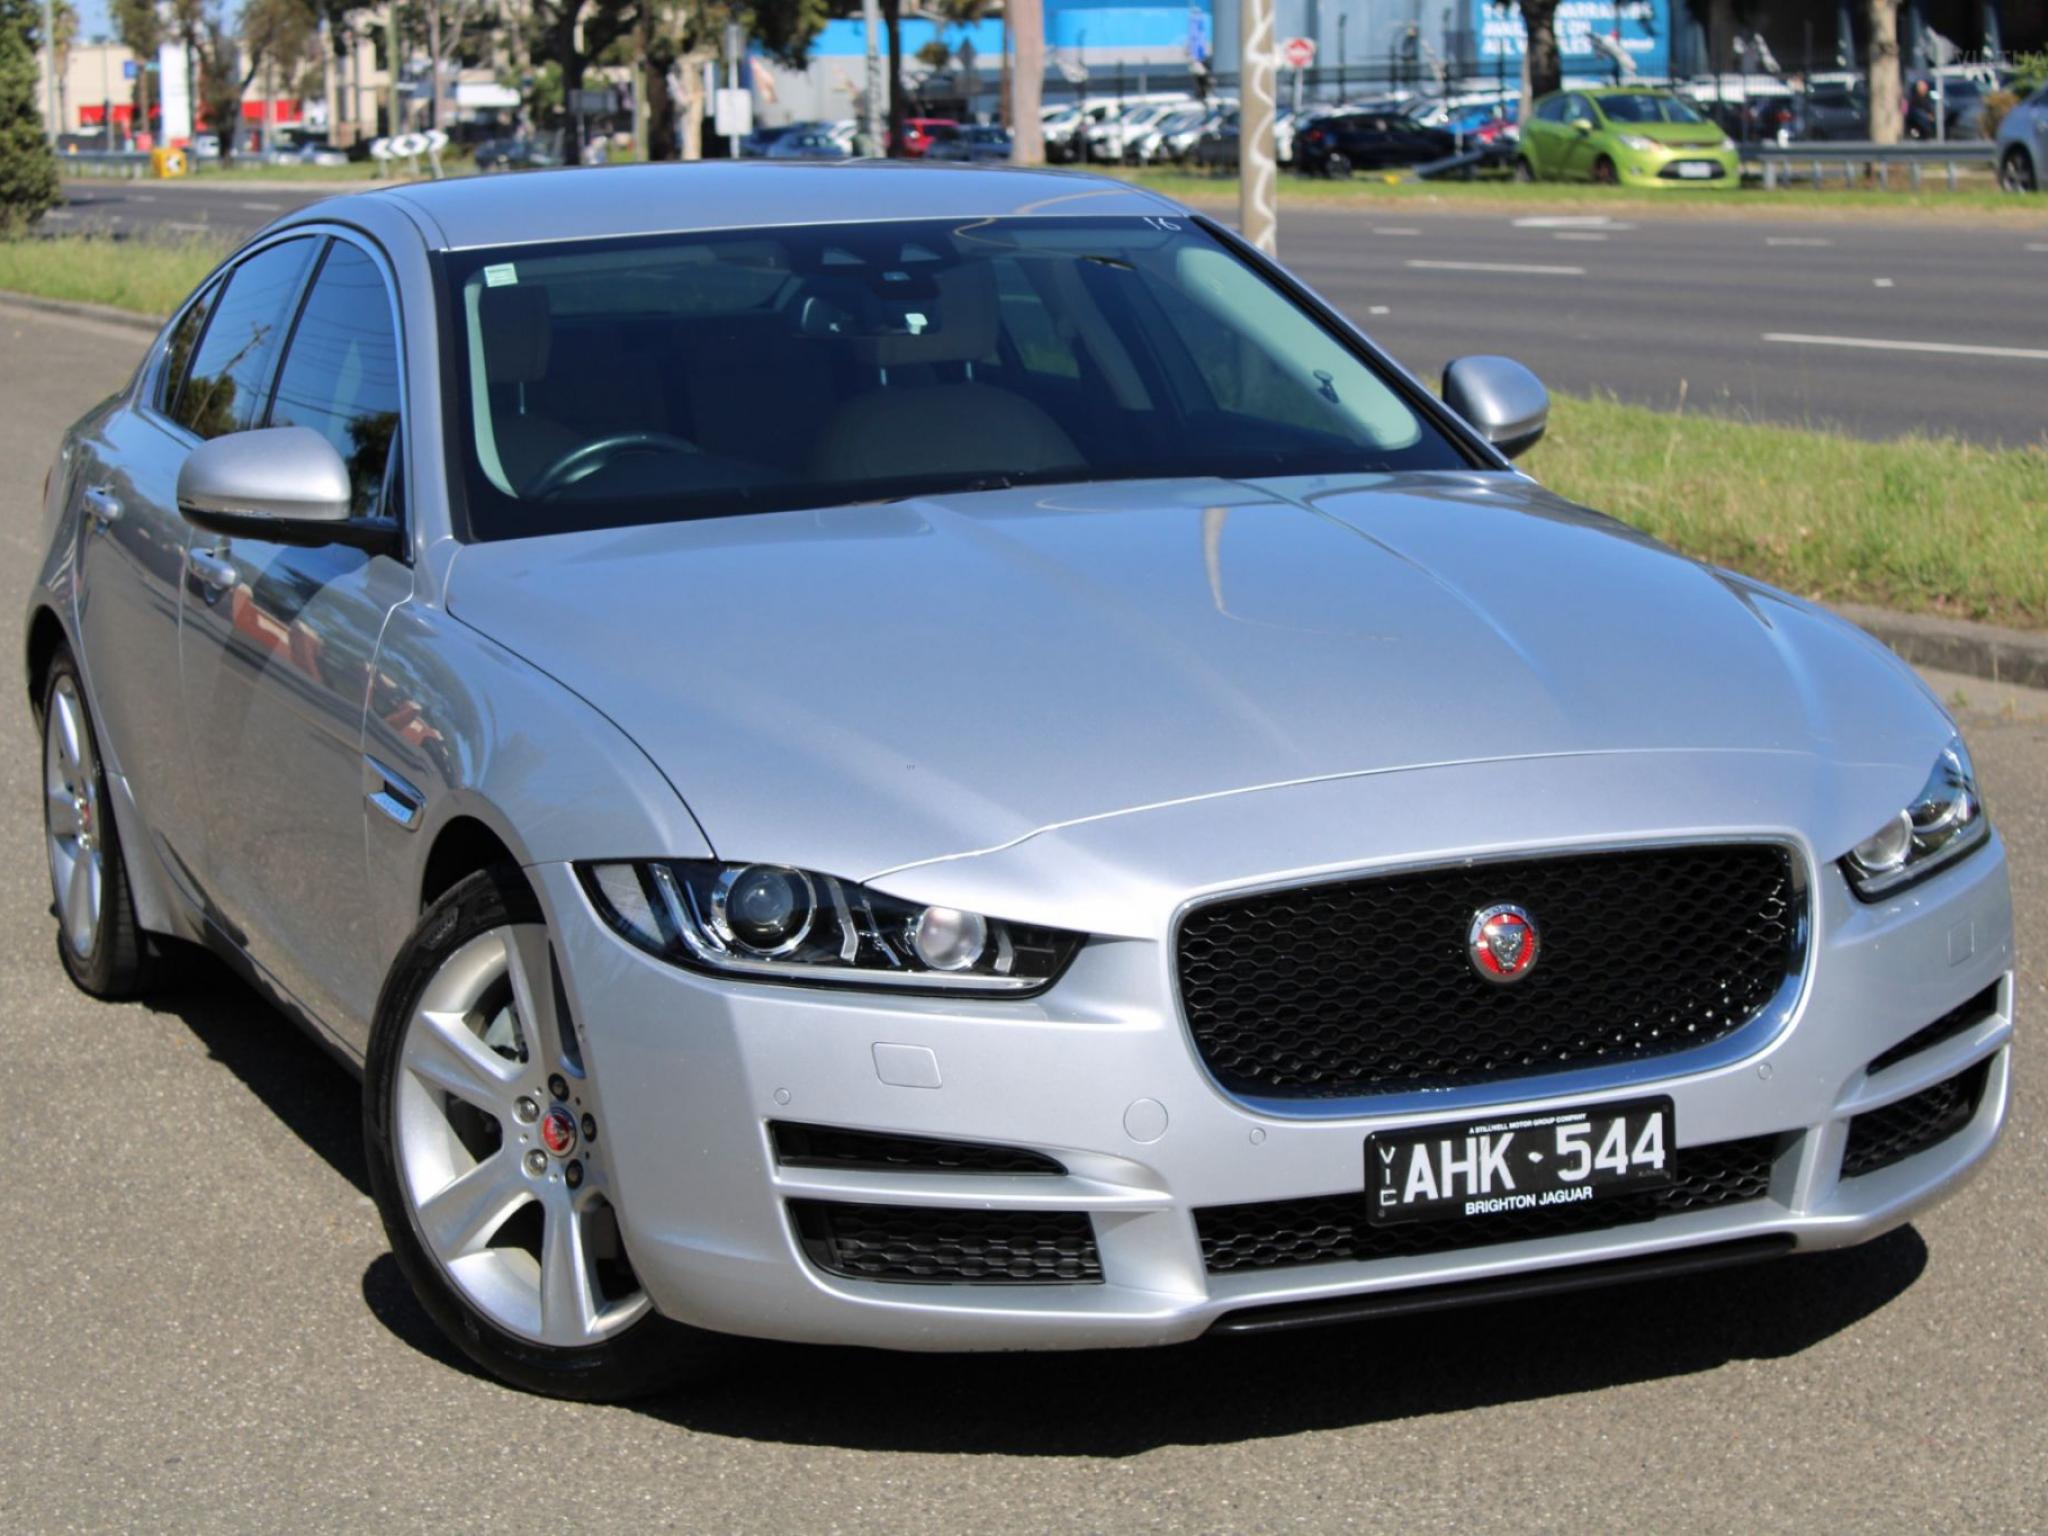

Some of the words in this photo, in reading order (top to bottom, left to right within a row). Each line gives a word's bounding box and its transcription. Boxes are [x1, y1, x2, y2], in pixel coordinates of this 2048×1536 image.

[1509, 1120, 1532, 1129] MOTOR
[1533, 1117, 1555, 1126] GROUP
[1556, 1113, 1587, 1123] COMPANY
[1380, 1146, 1397, 1206] VIC
[1403, 1132, 1516, 1203] AHK
[1556, 1112, 1665, 1182] 544
[1465, 1194, 1536, 1215] BRIGHTON
[1540, 1186, 1593, 1205] JAGUAR
